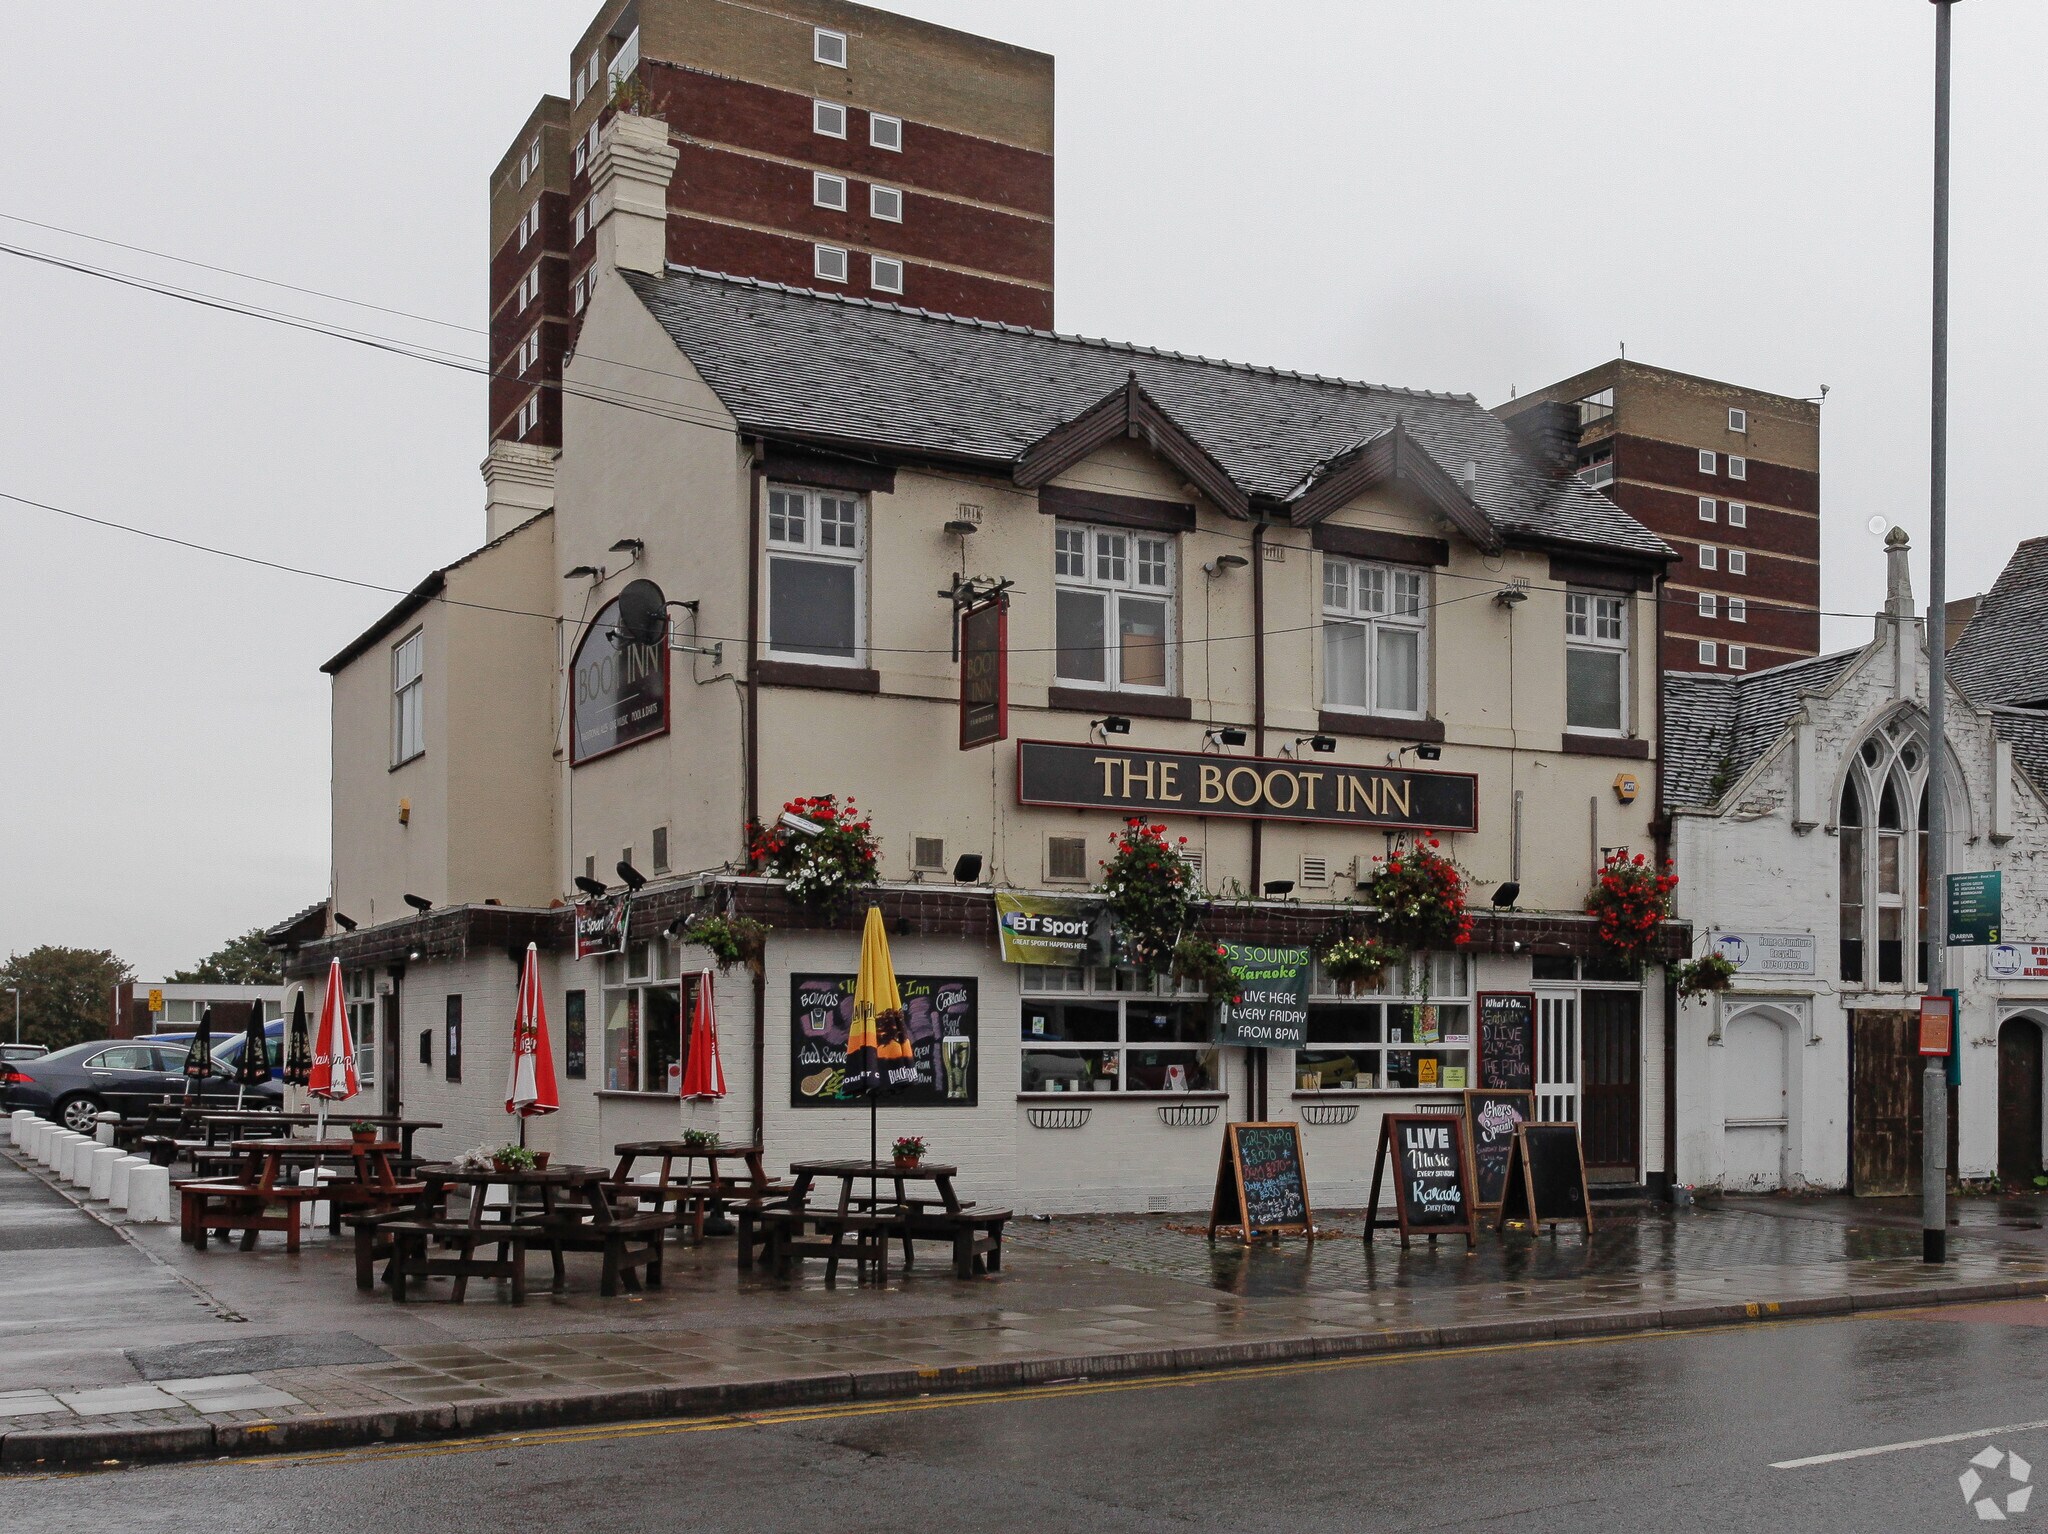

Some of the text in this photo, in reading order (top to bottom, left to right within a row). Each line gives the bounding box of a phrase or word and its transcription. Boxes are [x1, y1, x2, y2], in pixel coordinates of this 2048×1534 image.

[627, 642, 659, 685] INN
[1094, 757, 1411, 817] THE BOOT INN
[1013, 916, 1088, 936] BT Sport
[1760, 937, 1776, 946] Home
[1784, 938, 1812, 947] Furniture
[1989, 930, 1998, 942] S
[1049, 941, 1073, 949] HAPPENS
[1244, 946, 1308, 966] SOUNDS
[1770, 949, 1801, 959] Recycling
[1231, 965, 1296, 980] Karaoke
[905, 980, 930, 997] Inn
[1244, 991, 1297, 1005] LIVE HERE
[1485, 999, 1509, 1008] What's
[1232, 1008, 1306, 1023] EVERY FRIDAY
[1238, 1026, 1299, 1040] FROM 8PM
[1494, 1026, 1522, 1041] LIVE
[1482, 1058, 1499, 1075] THE
[1406, 1128, 1449, 1149] LIVE
[1407, 1149, 1450, 1170] Music
[1416, 1170, 1435, 1178] EVERY
[1413, 1180, 1460, 1204] Karaoke
